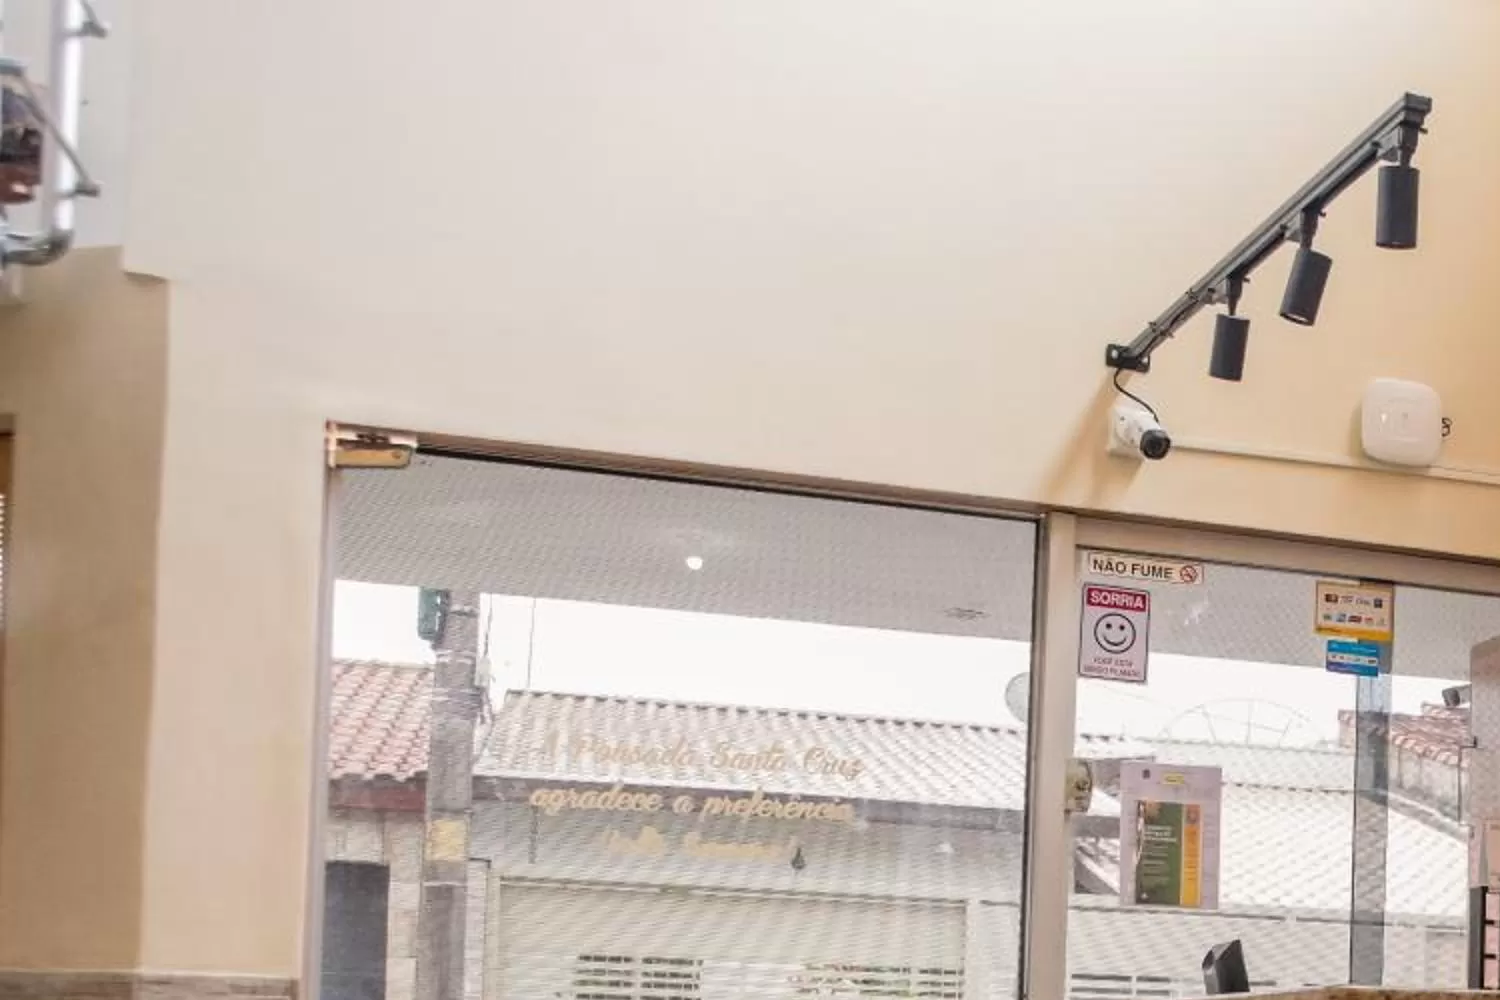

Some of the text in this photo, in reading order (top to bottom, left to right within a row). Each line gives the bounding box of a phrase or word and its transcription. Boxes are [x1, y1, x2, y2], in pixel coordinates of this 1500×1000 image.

[1093, 557, 1173, 579] NÃO FUME
[1090, 590, 1144, 609] SORRIA
[709, 740, 788, 773] Santa
[803, 744, 866, 781] Cruz
[529, 779, 664, 816] agradece
[672, 795, 695, 815] a
